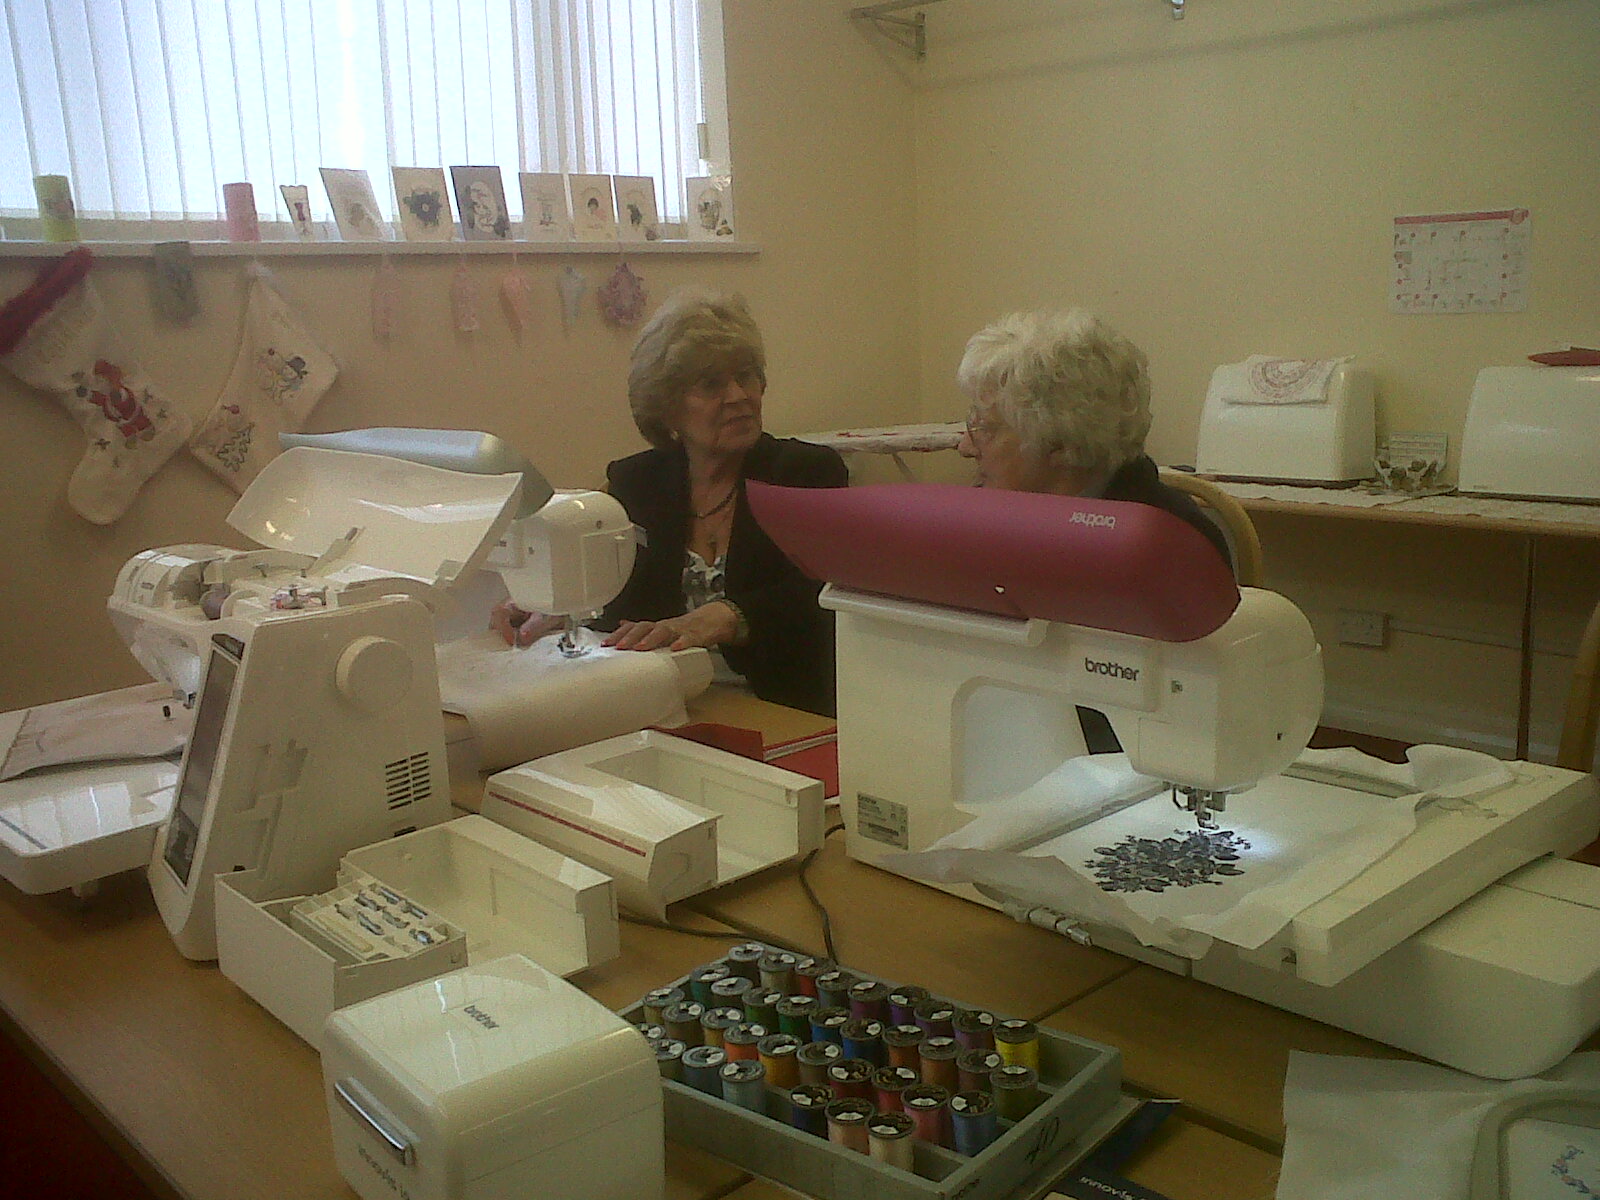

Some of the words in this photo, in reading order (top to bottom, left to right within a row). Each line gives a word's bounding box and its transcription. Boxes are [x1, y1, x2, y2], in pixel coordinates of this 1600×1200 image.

[1069, 511, 1117, 529] brother
[1084, 657, 1140, 681] brother
[463, 1004, 499, 1030] brother
